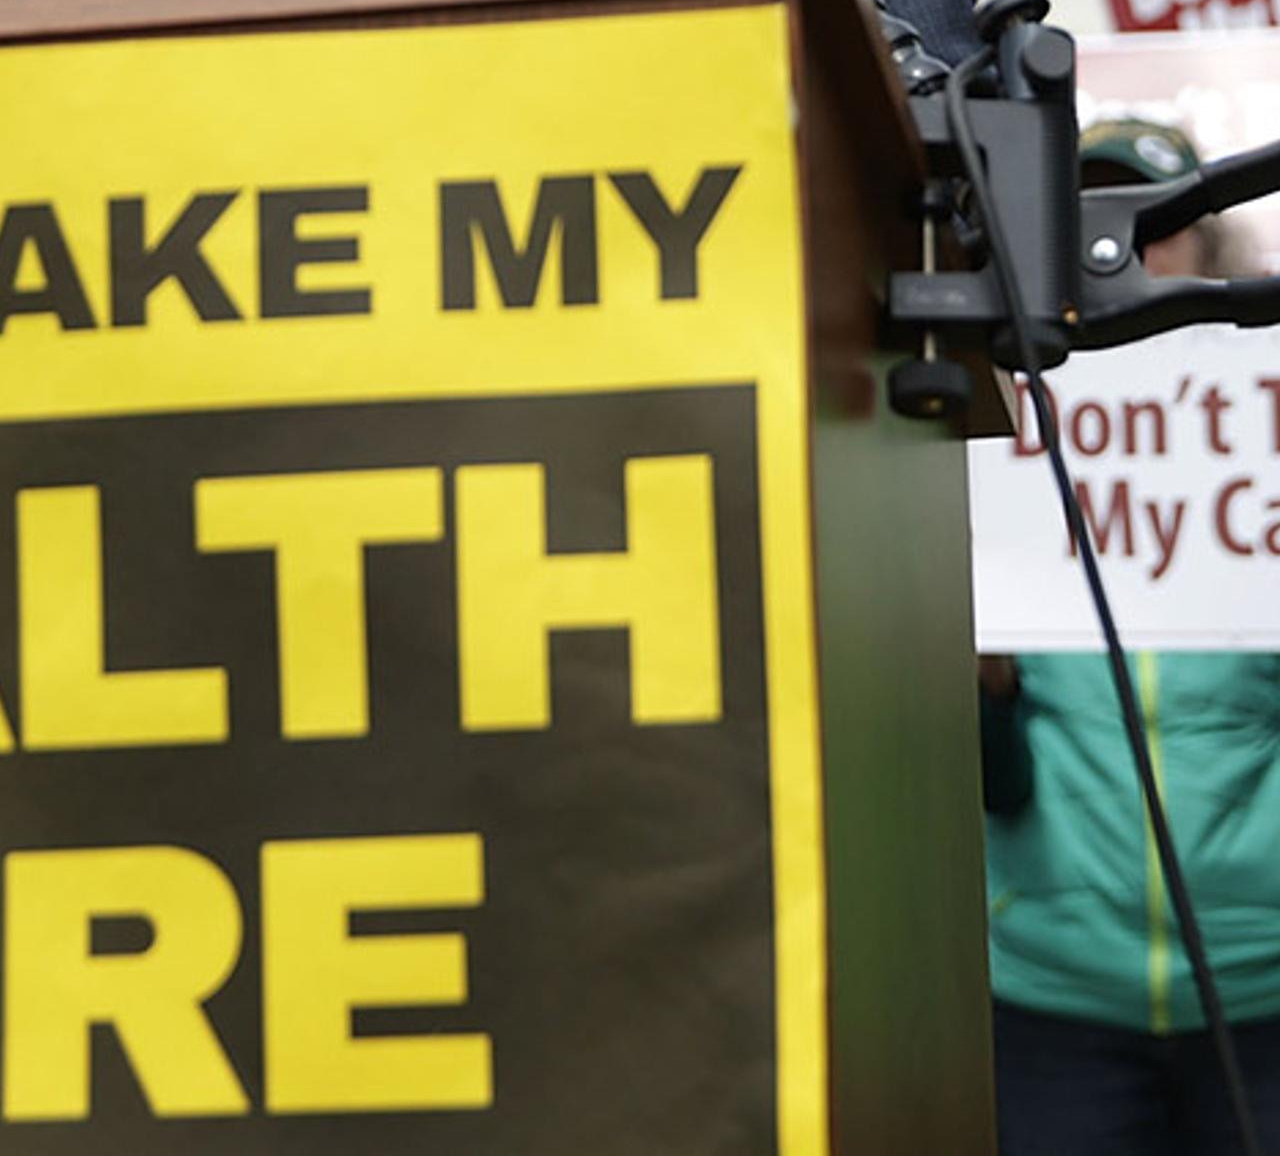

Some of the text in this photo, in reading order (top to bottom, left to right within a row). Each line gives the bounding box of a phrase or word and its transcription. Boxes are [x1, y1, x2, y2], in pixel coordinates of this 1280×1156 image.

[437, 164, 745, 312] MY
[1014, 375, 1232, 457] Don't
[1066, 478, 1186, 580] My
